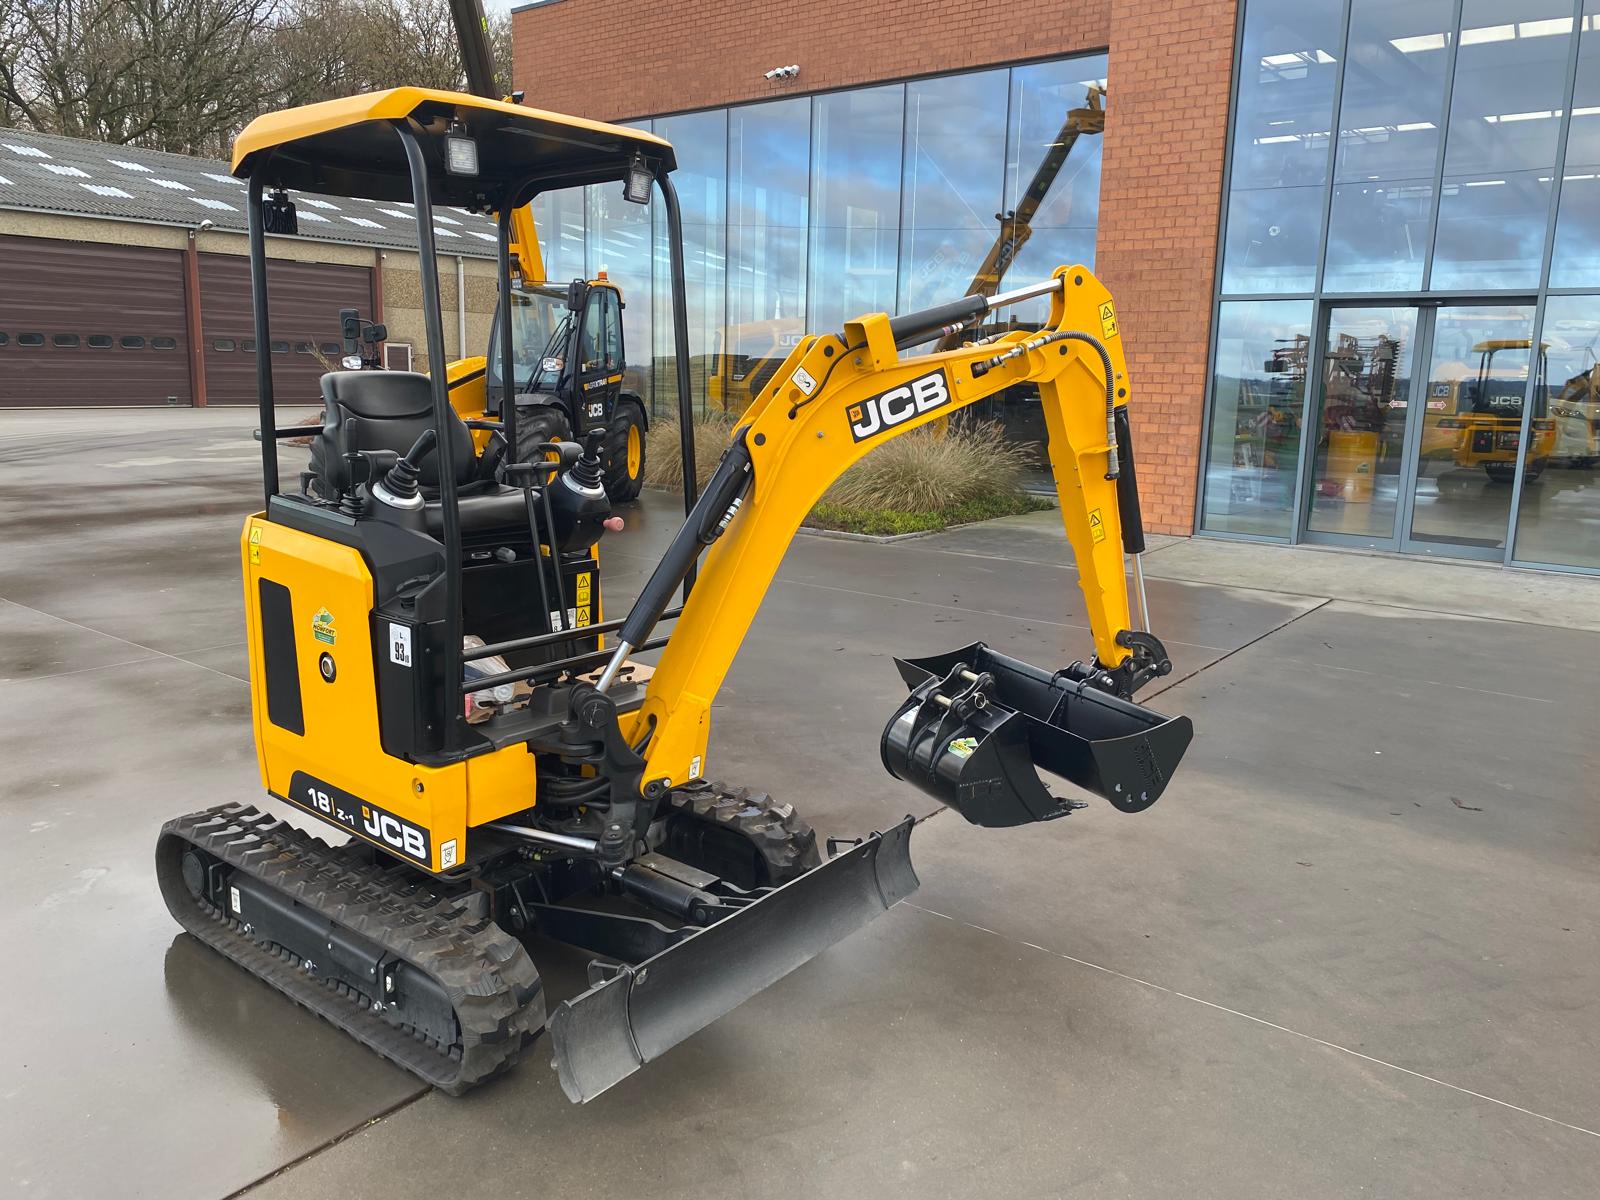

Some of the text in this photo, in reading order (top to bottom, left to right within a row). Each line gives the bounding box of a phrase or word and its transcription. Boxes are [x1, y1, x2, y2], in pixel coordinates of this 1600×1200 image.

[588, 403, 603, 417] JCB
[853, 373, 949, 438] JCB
[1489, 396, 1523, 405] JCB
[308, 787, 330, 813] 18
[363, 808, 427, 860] JCB
